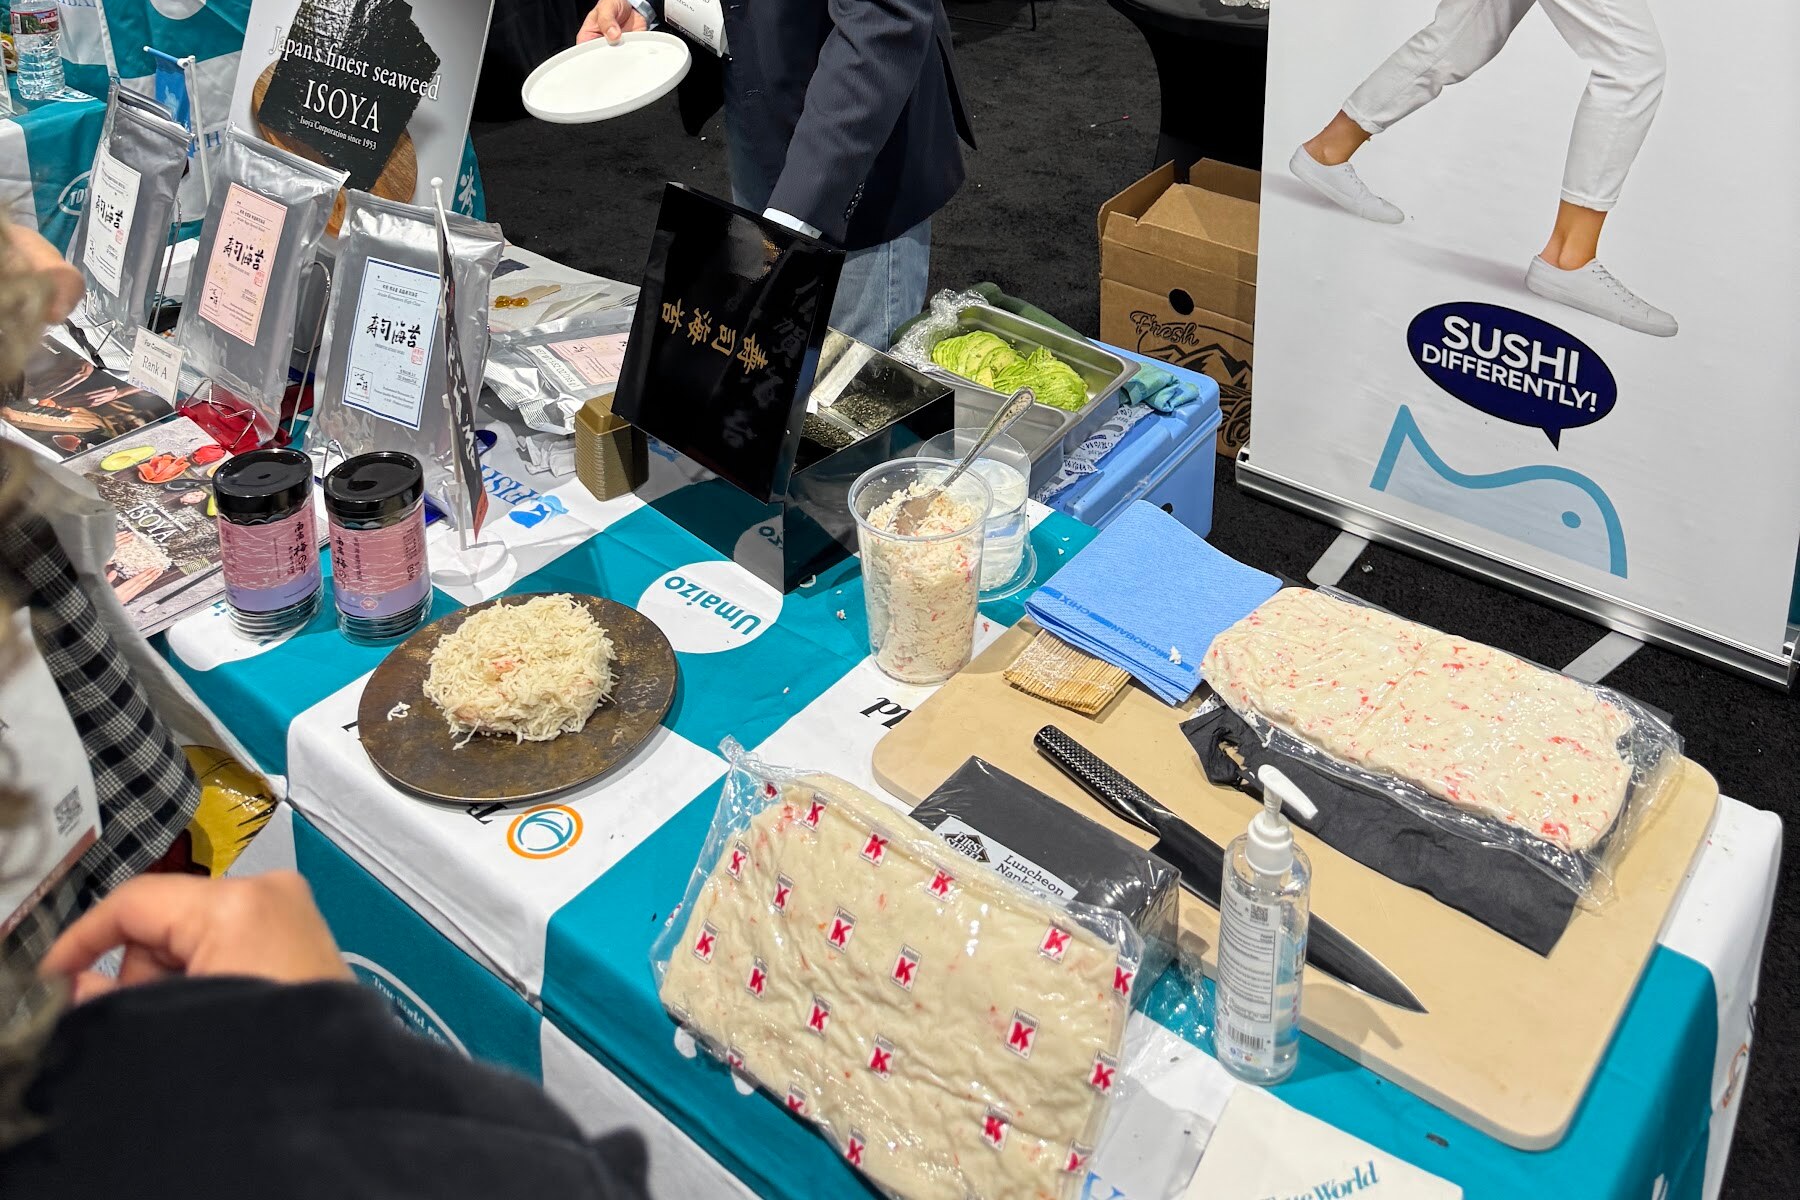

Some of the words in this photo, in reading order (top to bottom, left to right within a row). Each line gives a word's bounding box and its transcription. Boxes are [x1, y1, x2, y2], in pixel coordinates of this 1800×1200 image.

[269, 27, 322, 63] Japan's
[325, 43, 369, 78] finest
[372, 65, 441, 101] seaweed
[303, 79, 380, 134] ISOYA
[300, 116, 314, 130] Isoya
[314, 121, 347, 141] Corporation
[347, 131, 362, 145] since
[363, 137, 377, 151] 1953
[1130, 310, 1200, 346] Fresh
[142, 355, 159, 376] Rank
[160, 366, 167, 380] A
[1441, 315, 1580, 385] SUSHI
[1421, 343, 1598, 413] DIFFERENTLY!
[125, 503, 178, 543] ISOYA
[664, 576, 762, 636] Umaizo
[954, 832, 984, 852] FIRST
[1003, 854, 1065, 897] Luncheon
[1312, 1160, 1380, 1200] World
